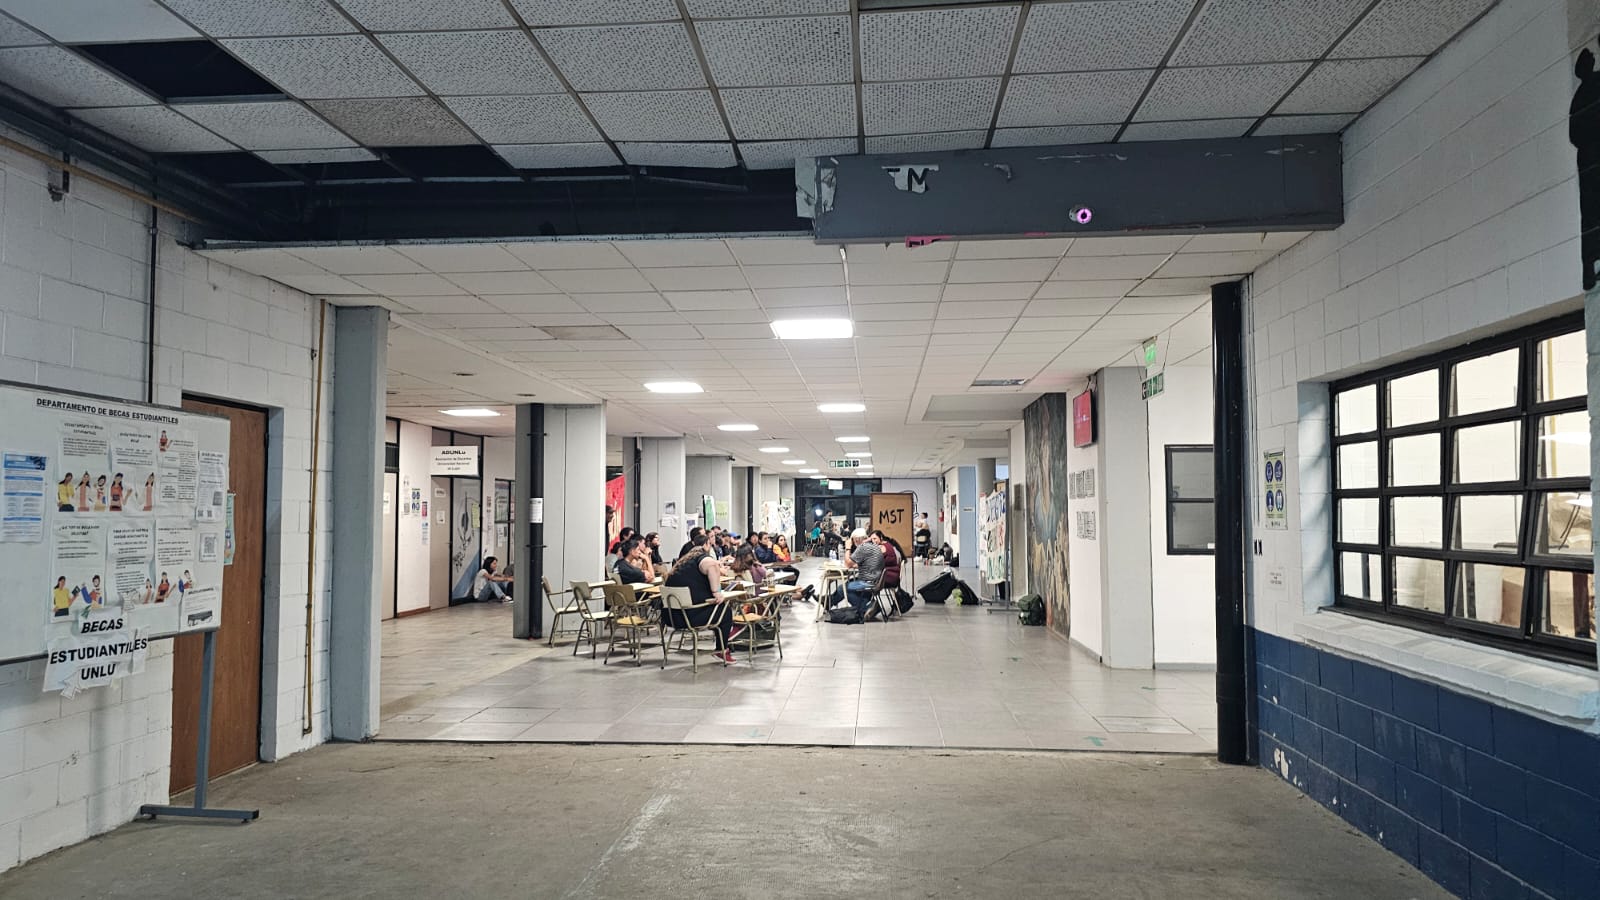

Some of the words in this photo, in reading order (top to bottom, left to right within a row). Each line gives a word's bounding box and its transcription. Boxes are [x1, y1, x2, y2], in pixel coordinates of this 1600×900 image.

[36, 398, 96, 413] DEPARTAMENTO
[98, 407, 107, 415] DE
[108, 409, 130, 418] BECAS
[132, 412, 179, 424] ESTUDIANTILES
[879, 508, 904, 525] MST
[81, 618, 123, 634] BECAS
[50, 638, 147, 665] ESTUDIANTILES
[81, 663, 116, 680] UNLU
